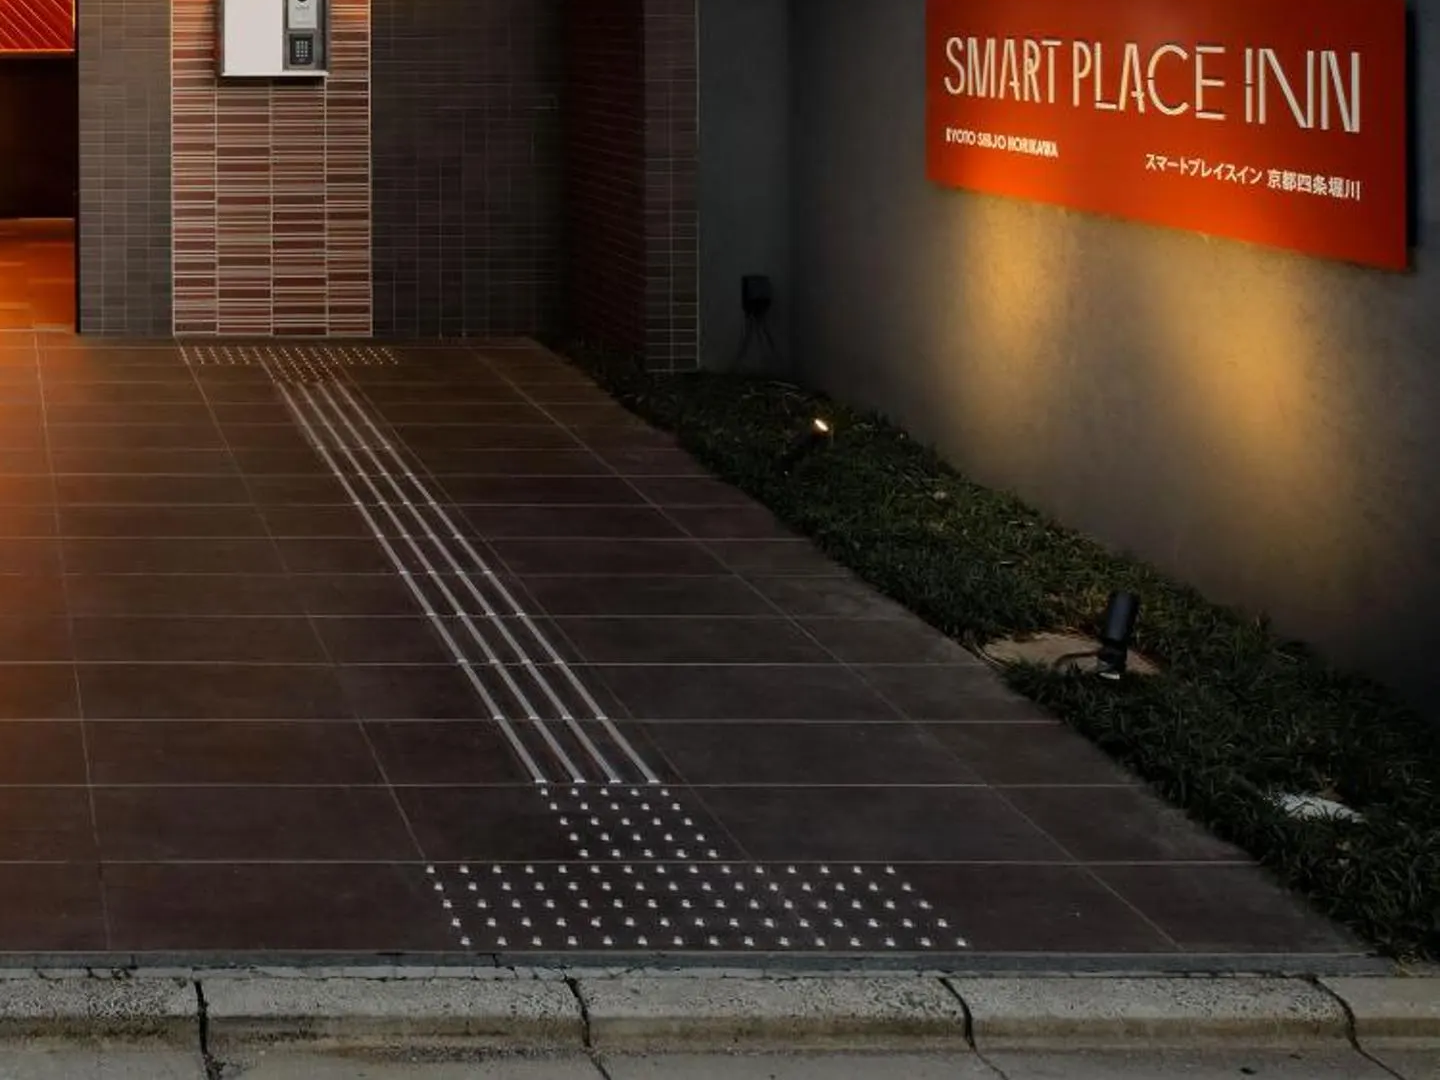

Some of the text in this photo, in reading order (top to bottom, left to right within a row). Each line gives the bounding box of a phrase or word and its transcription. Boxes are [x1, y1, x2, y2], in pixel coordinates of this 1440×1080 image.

[944, 36, 1360, 134] SMART PLACE INN
